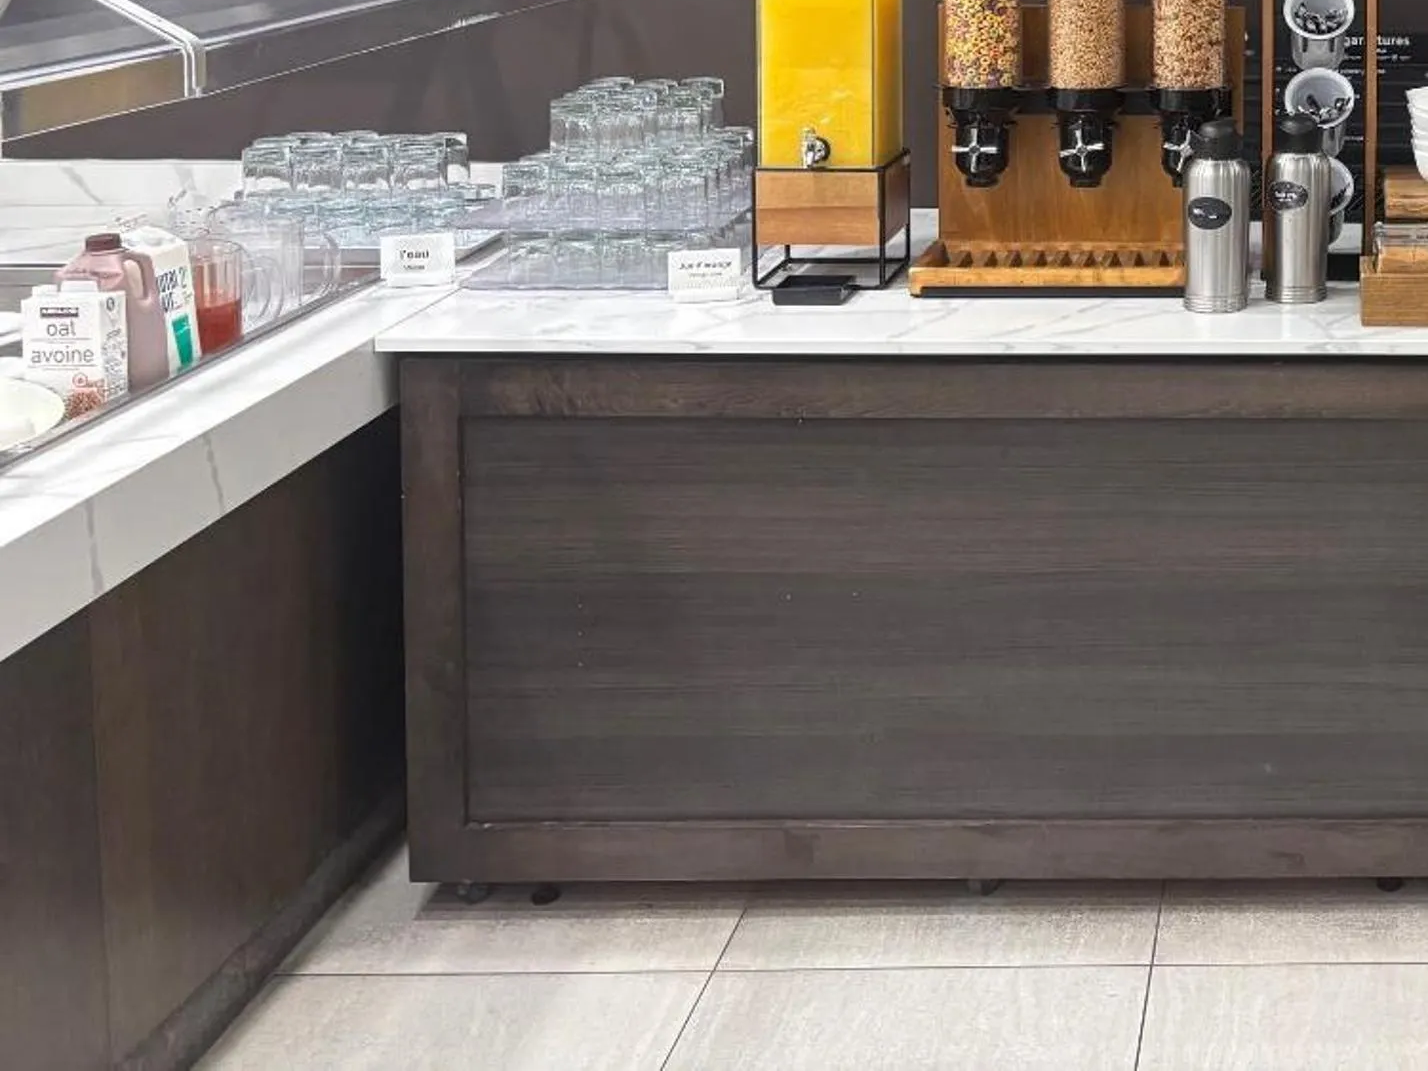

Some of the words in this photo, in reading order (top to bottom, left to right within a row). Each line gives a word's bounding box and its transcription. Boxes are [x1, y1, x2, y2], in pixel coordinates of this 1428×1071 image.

[1343, 34, 1411, 46] gartures
[46, 318, 77, 337] oat
[30, 344, 95, 364] avoine
